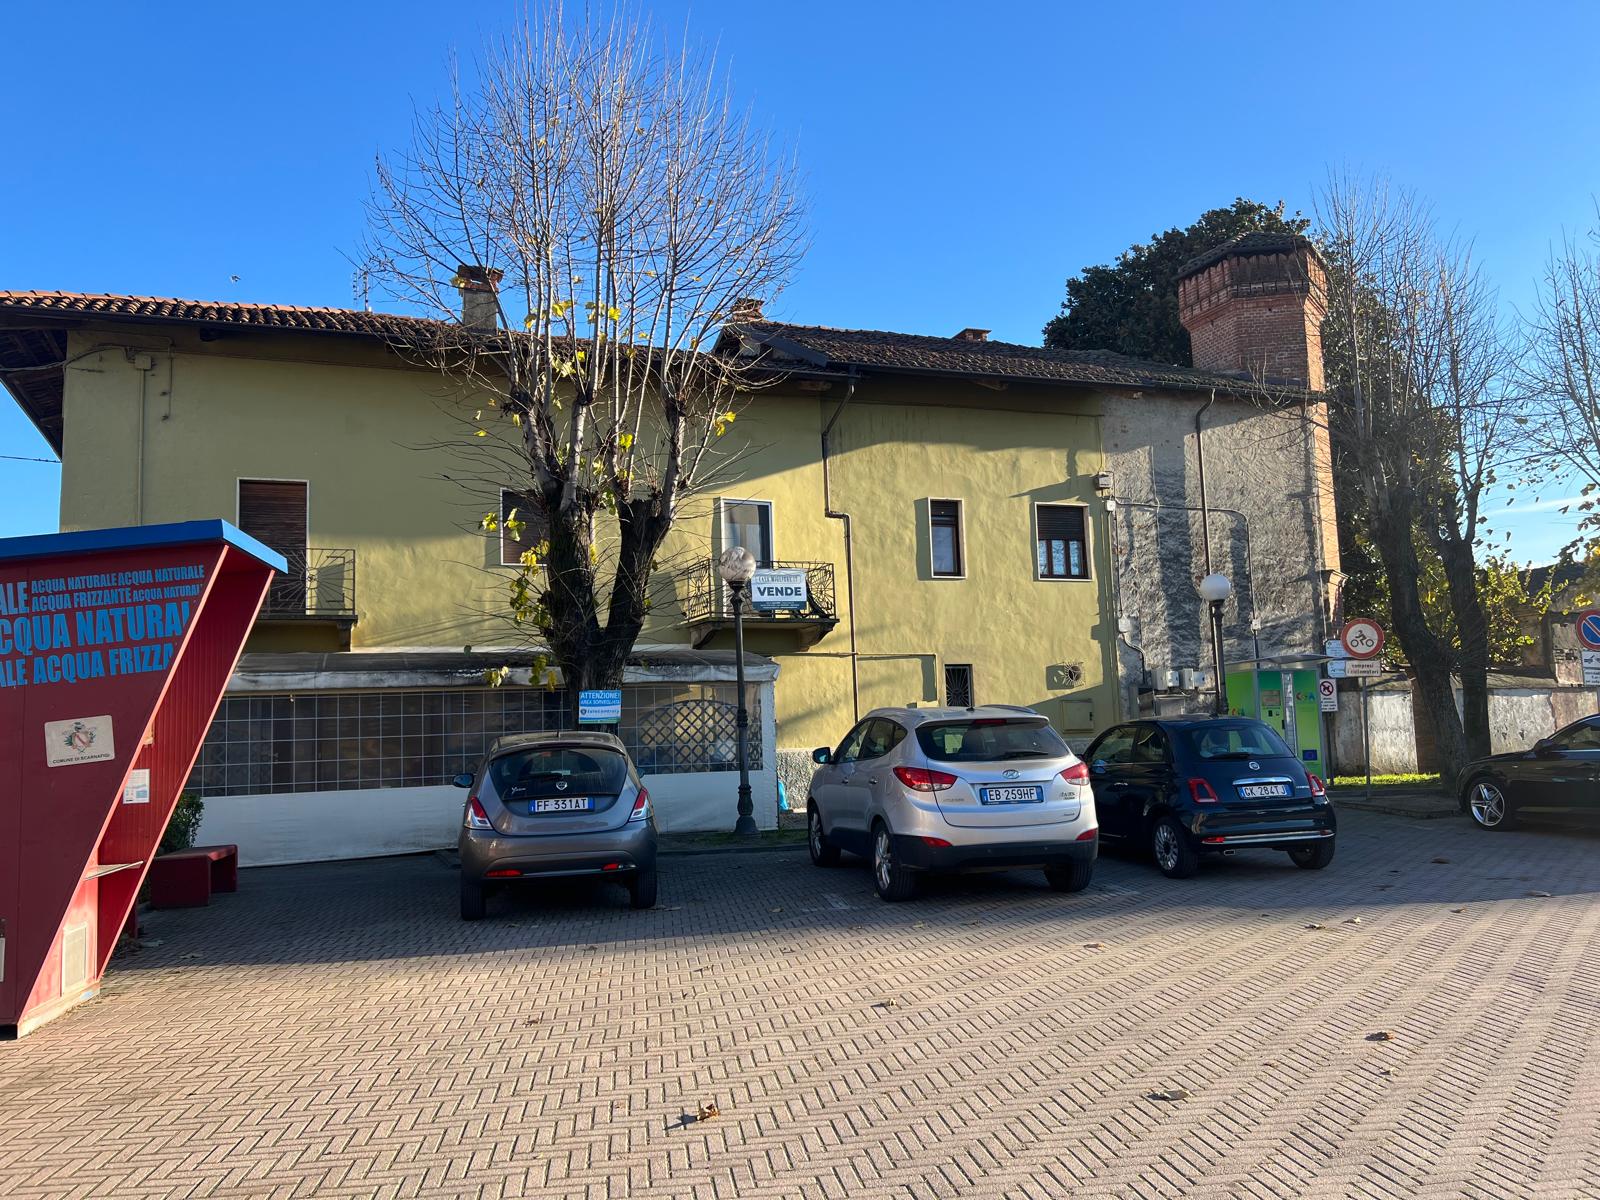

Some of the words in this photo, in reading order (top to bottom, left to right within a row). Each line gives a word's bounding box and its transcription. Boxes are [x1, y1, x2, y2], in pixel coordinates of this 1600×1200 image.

[32, 579, 66, 593] ACQUA
[68, 573, 117, 589] NATURALE
[118, 570, 153, 585] ACQUA
[155, 566, 204, 582] NATURALE
[32, 593, 72, 612] ACQUA
[74, 588, 132, 607] FRIZZANTE
[133, 588, 162, 602] ACQUA
[757, 586, 802, 596] VENDE
[33, 651, 104, 683] ACQUA
[988, 790, 1002, 801] EB
[1005, 788, 1035, 800] 259HF
[536, 801, 550, 811] FF
[554, 798, 587, 810] 331AT
